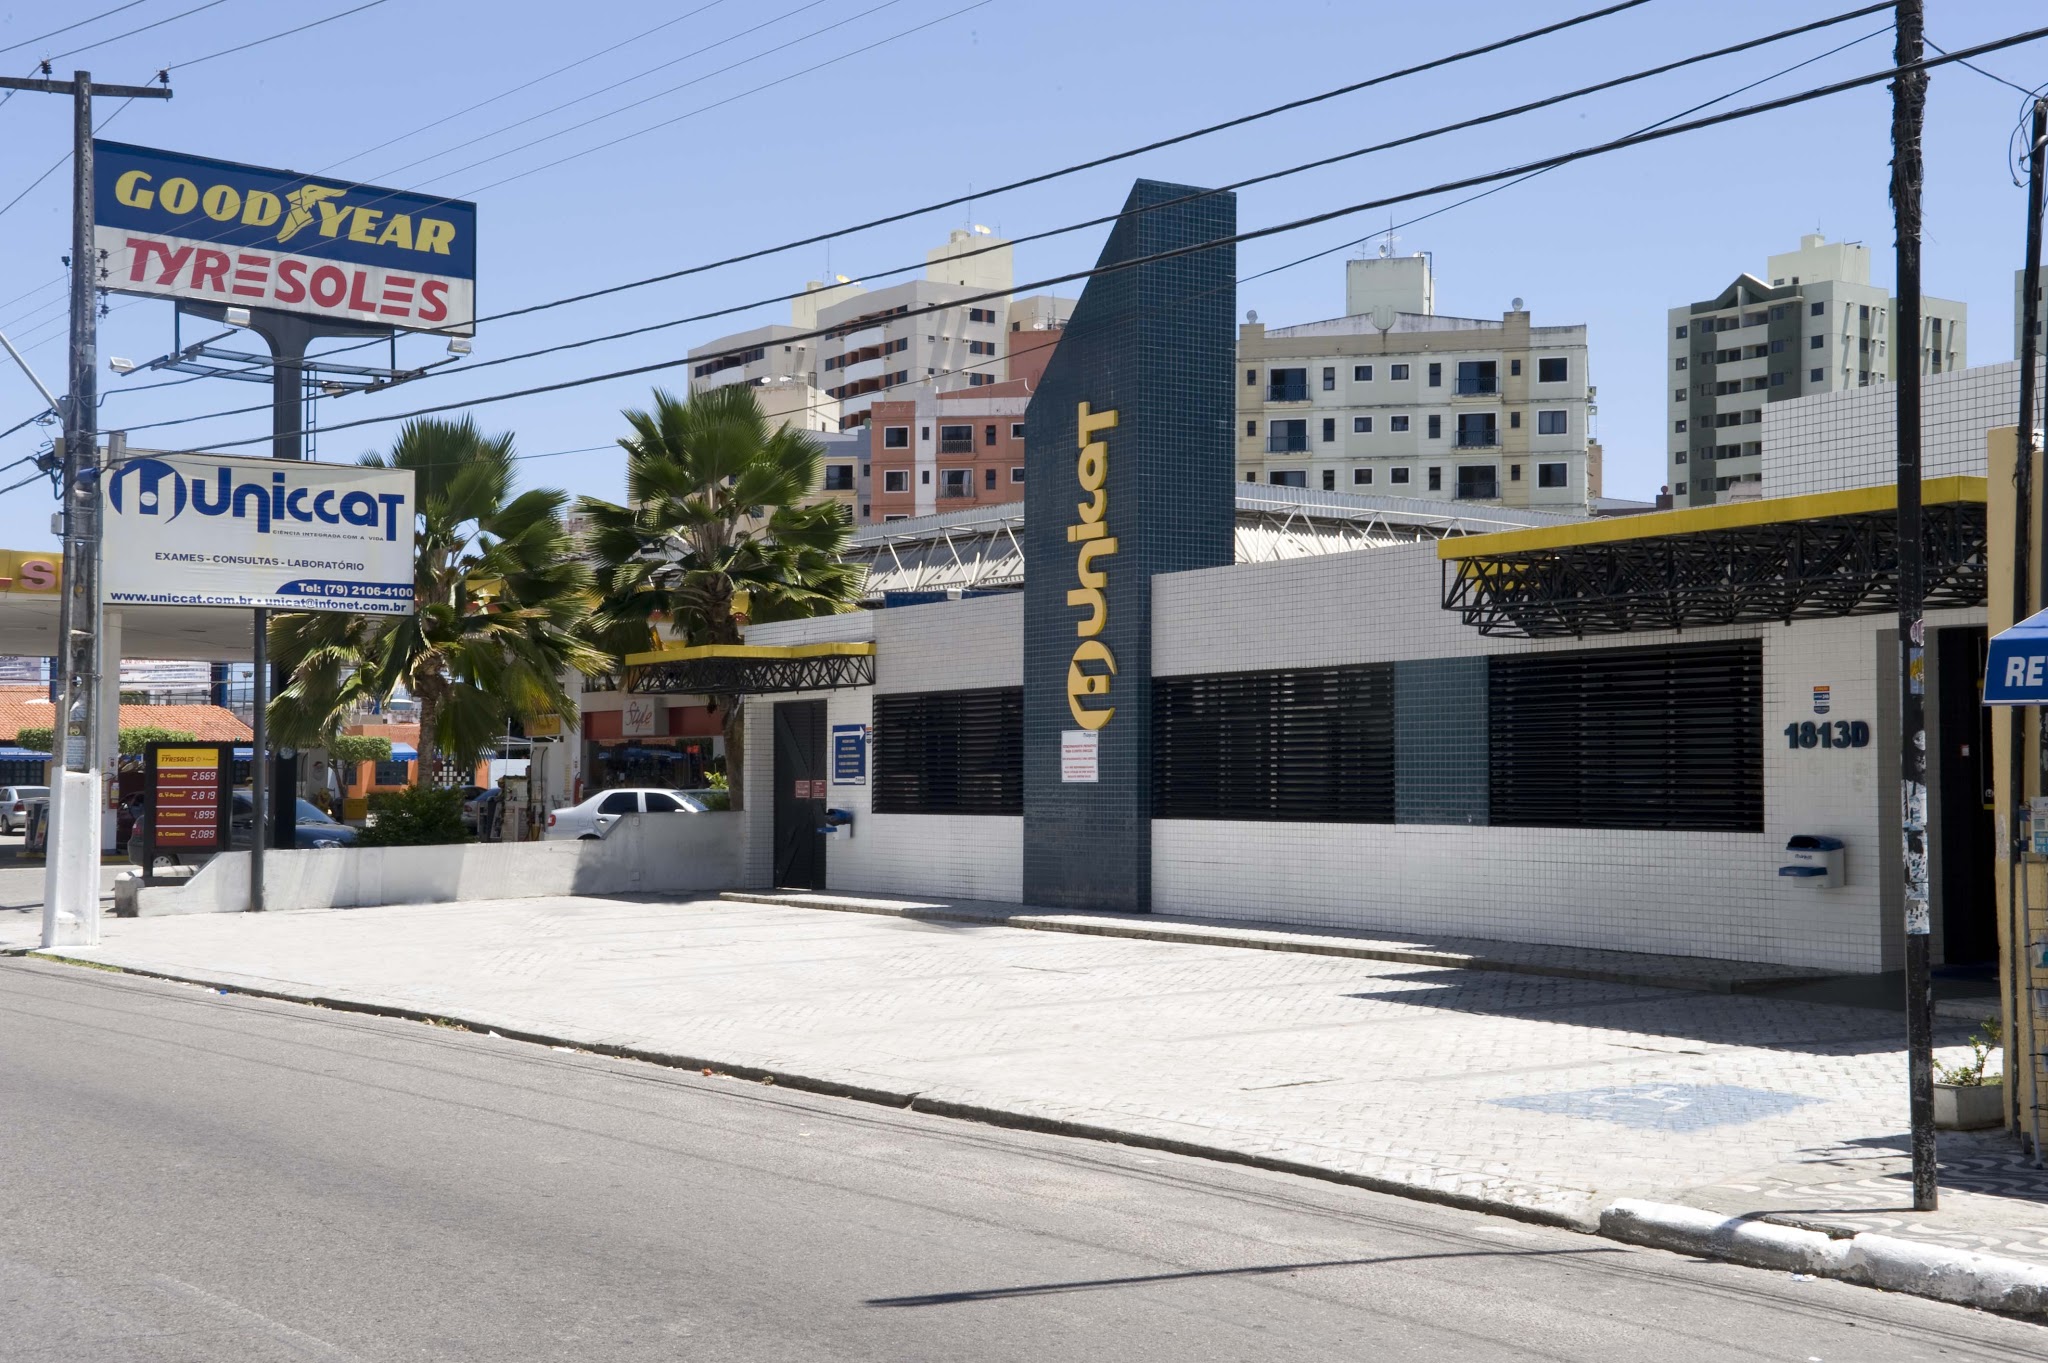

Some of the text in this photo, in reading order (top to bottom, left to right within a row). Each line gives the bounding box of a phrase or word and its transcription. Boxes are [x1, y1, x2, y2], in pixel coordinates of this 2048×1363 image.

[126, 238, 449, 322] TYRESOLES
[20, 560, 63, 590] S
[155, 552, 365, 571] EXAMES CONSULTAS LABORATÓRIO
[110, 591, 407, 612] www.uniccat.com.br unicat@infonet.com.br
[298, 583, 413, 597] Tel: (79) 2106-4100
[2004, 656, 2048, 687] RE
[625, 701, 653, 733] Style
[1784, 720, 1870, 749] 1813D
